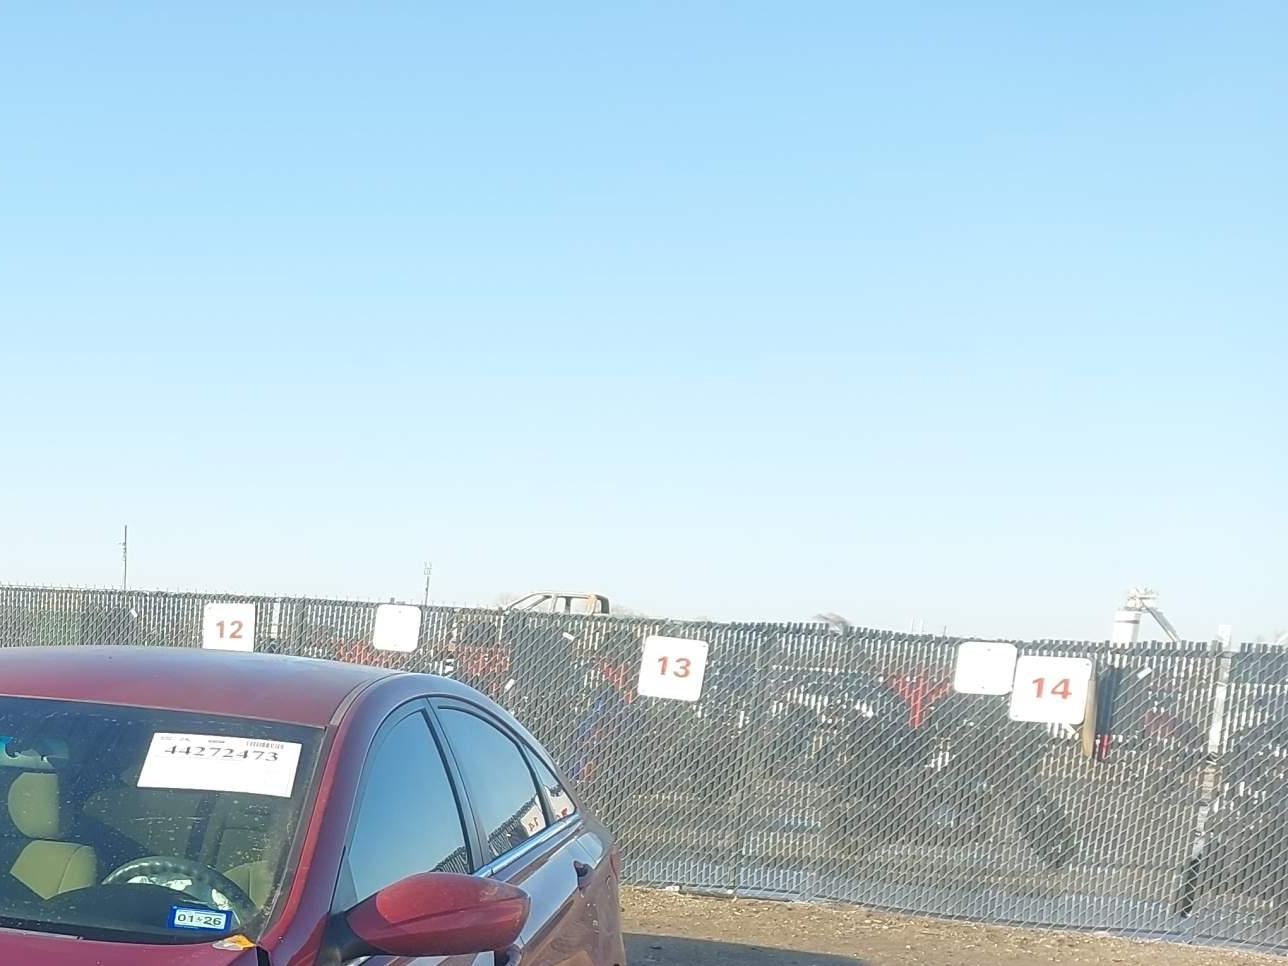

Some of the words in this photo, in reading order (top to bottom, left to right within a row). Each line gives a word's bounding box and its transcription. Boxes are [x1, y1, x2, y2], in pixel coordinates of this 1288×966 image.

[215, 620, 244, 639] 12
[657, 655, 691, 678] 13
[1031, 677, 1072, 699] 14
[164, 744, 279, 762] 44272473
